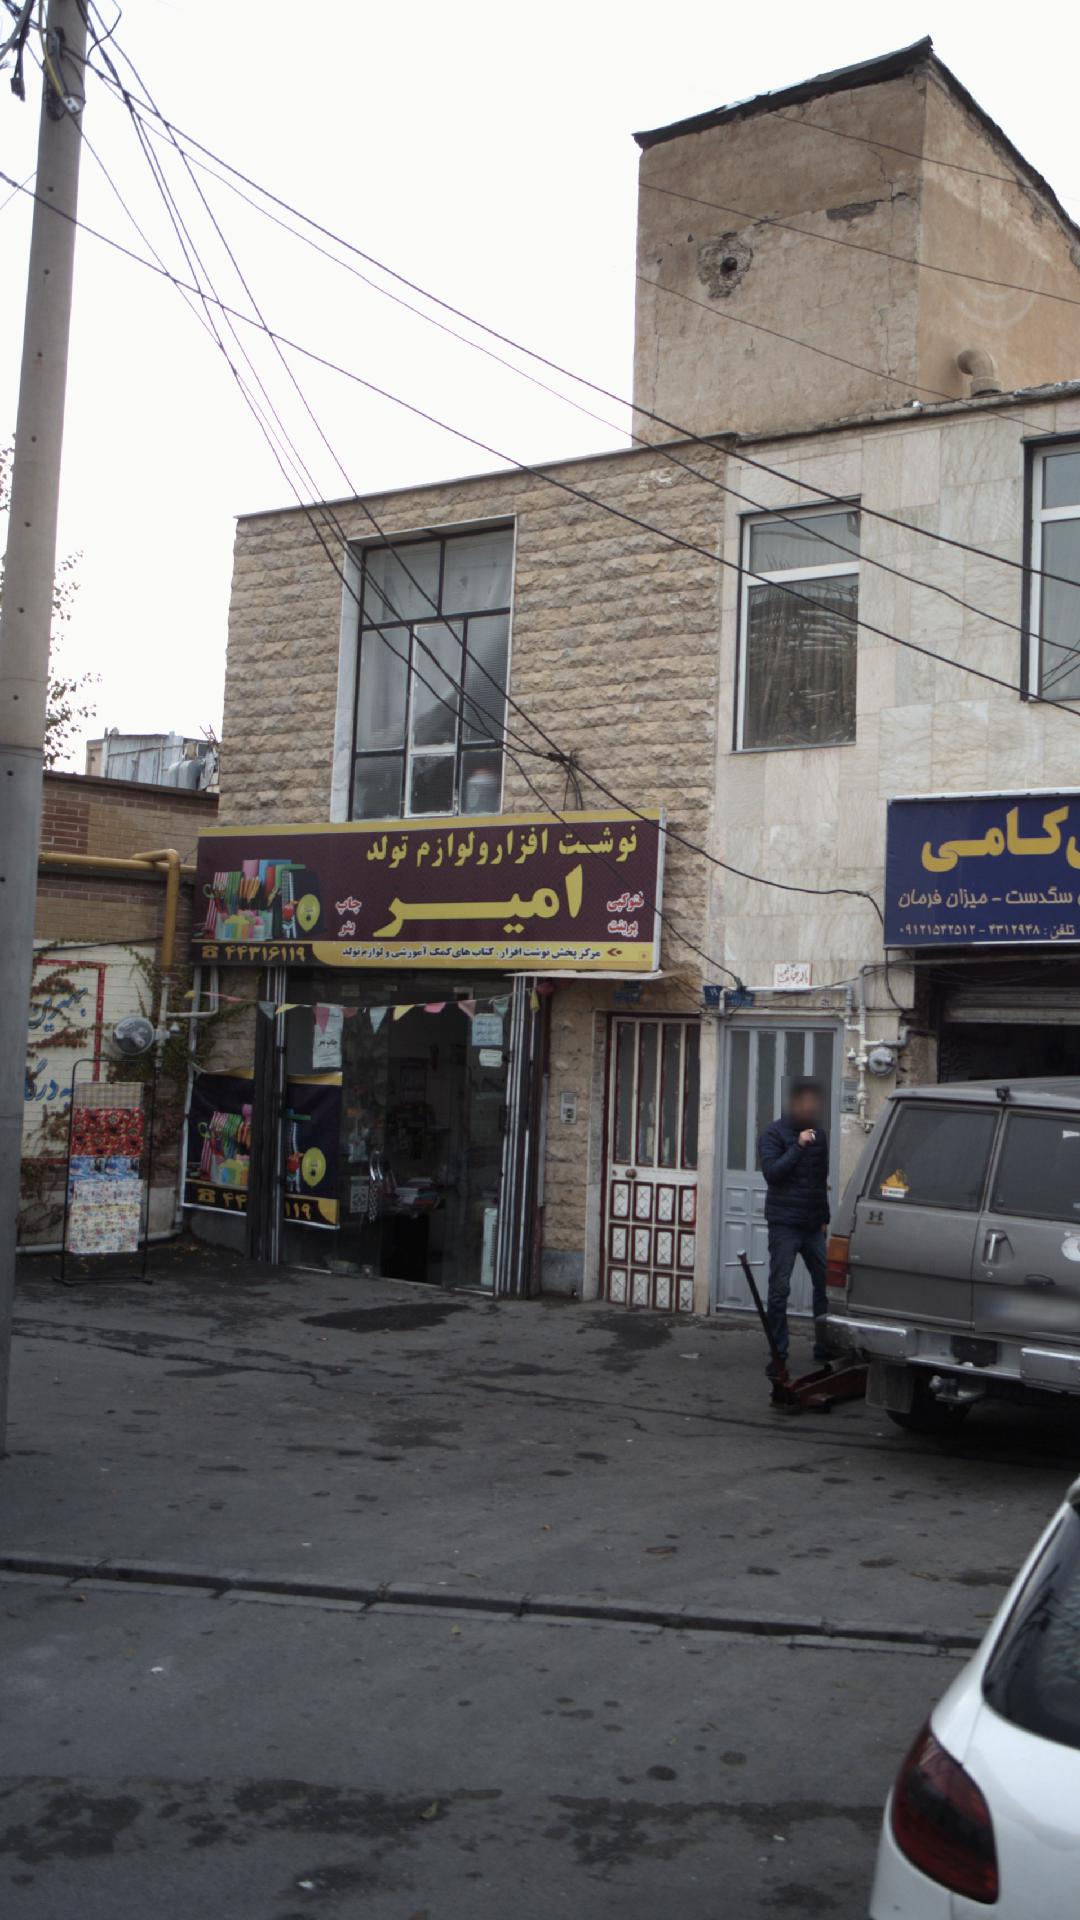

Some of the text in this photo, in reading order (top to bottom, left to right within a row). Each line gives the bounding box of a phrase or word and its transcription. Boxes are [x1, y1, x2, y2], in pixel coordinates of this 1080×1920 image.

[417, 830, 475, 868] لوازم
[491, 827, 549, 865] افزار
[559, 825, 637, 862] نوشت
[921, 805, 1069, 873] کامی
[367, 834, 409, 869] تولد
[335, 896, 362, 915] چاپ
[373, 863, 583, 937] امیر
[898, 888, 942, 908] فرمان
[946, 888, 988, 908] میزان
[608, 919, 639, 937] پرینت
[224, 944, 306, 961] ۴۴۳۱۶۱۱۹
[429, 947, 451, 956] کمک
[523, 947, 550, 958] نوشت
[551, 947, 577, 959] پخش
[580, 947, 601, 959] مرکز
